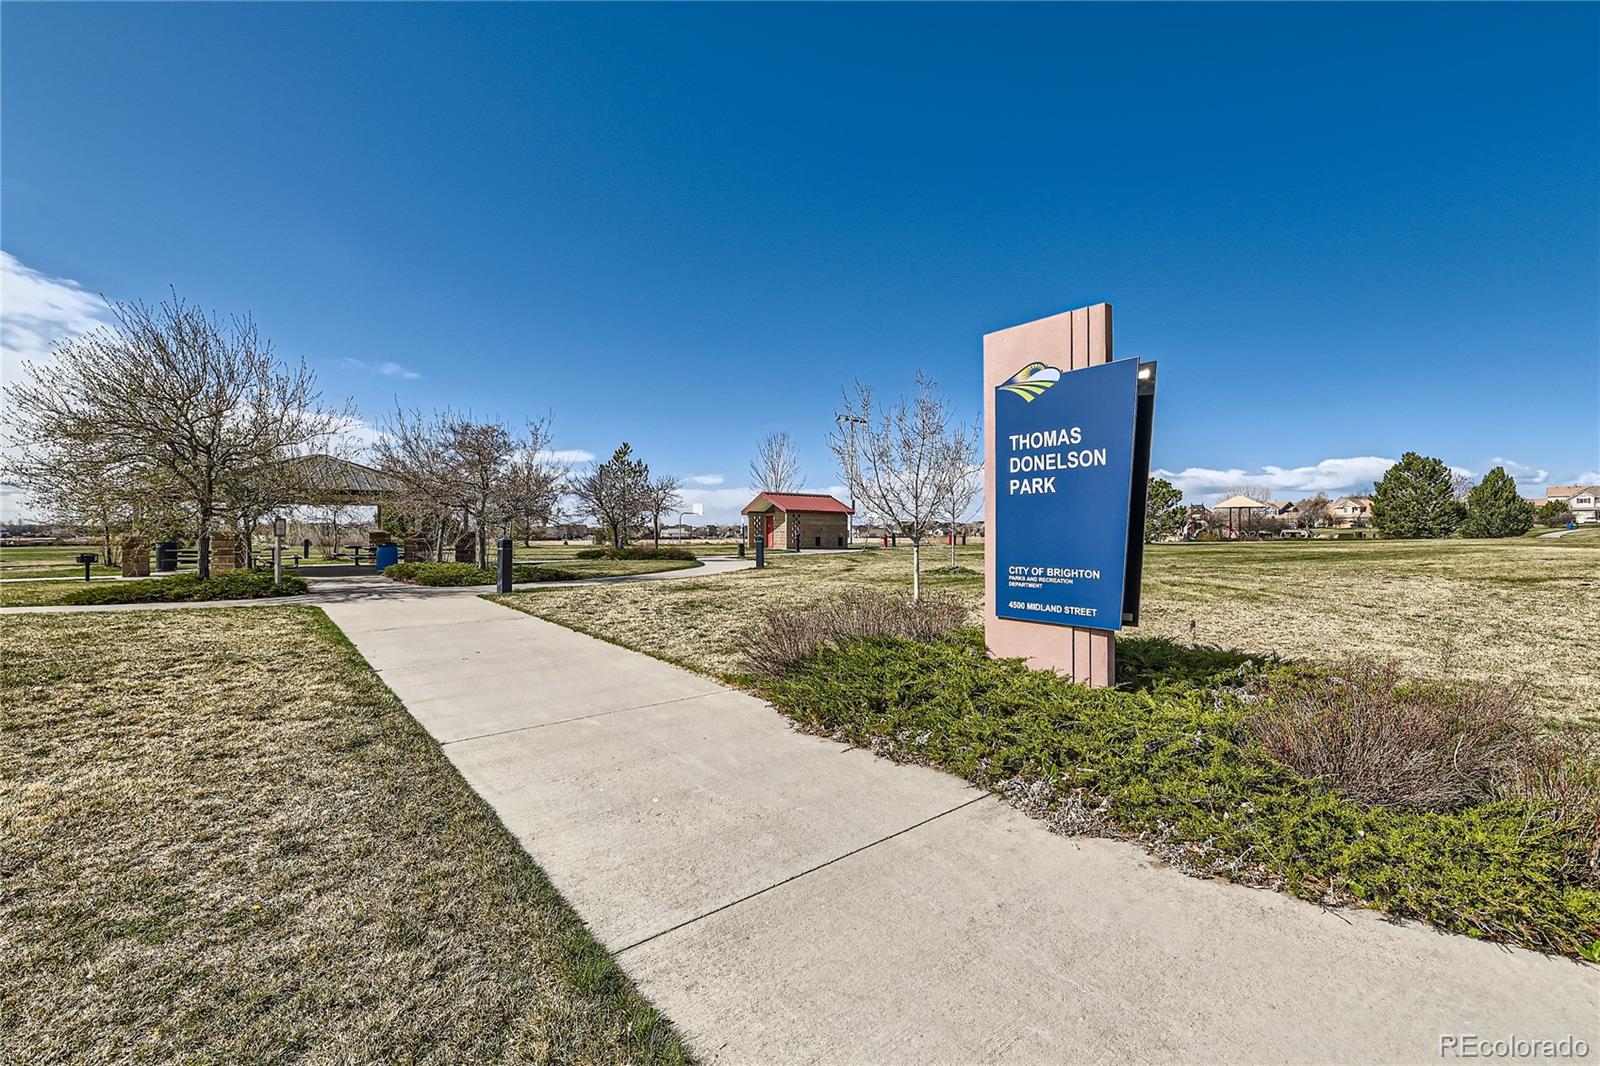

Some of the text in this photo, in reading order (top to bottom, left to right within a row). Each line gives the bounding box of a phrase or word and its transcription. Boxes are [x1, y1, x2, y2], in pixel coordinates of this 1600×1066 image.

[1009, 427, 1082, 451] THOMAS
[1010, 448, 1107, 473] DONELSON
[1010, 477, 1056, 495] PARK
[1009, 566, 1100, 579] CITY OF BRIGHTON
[1009, 601, 1097, 616] 4500 MIDLAND STREET
